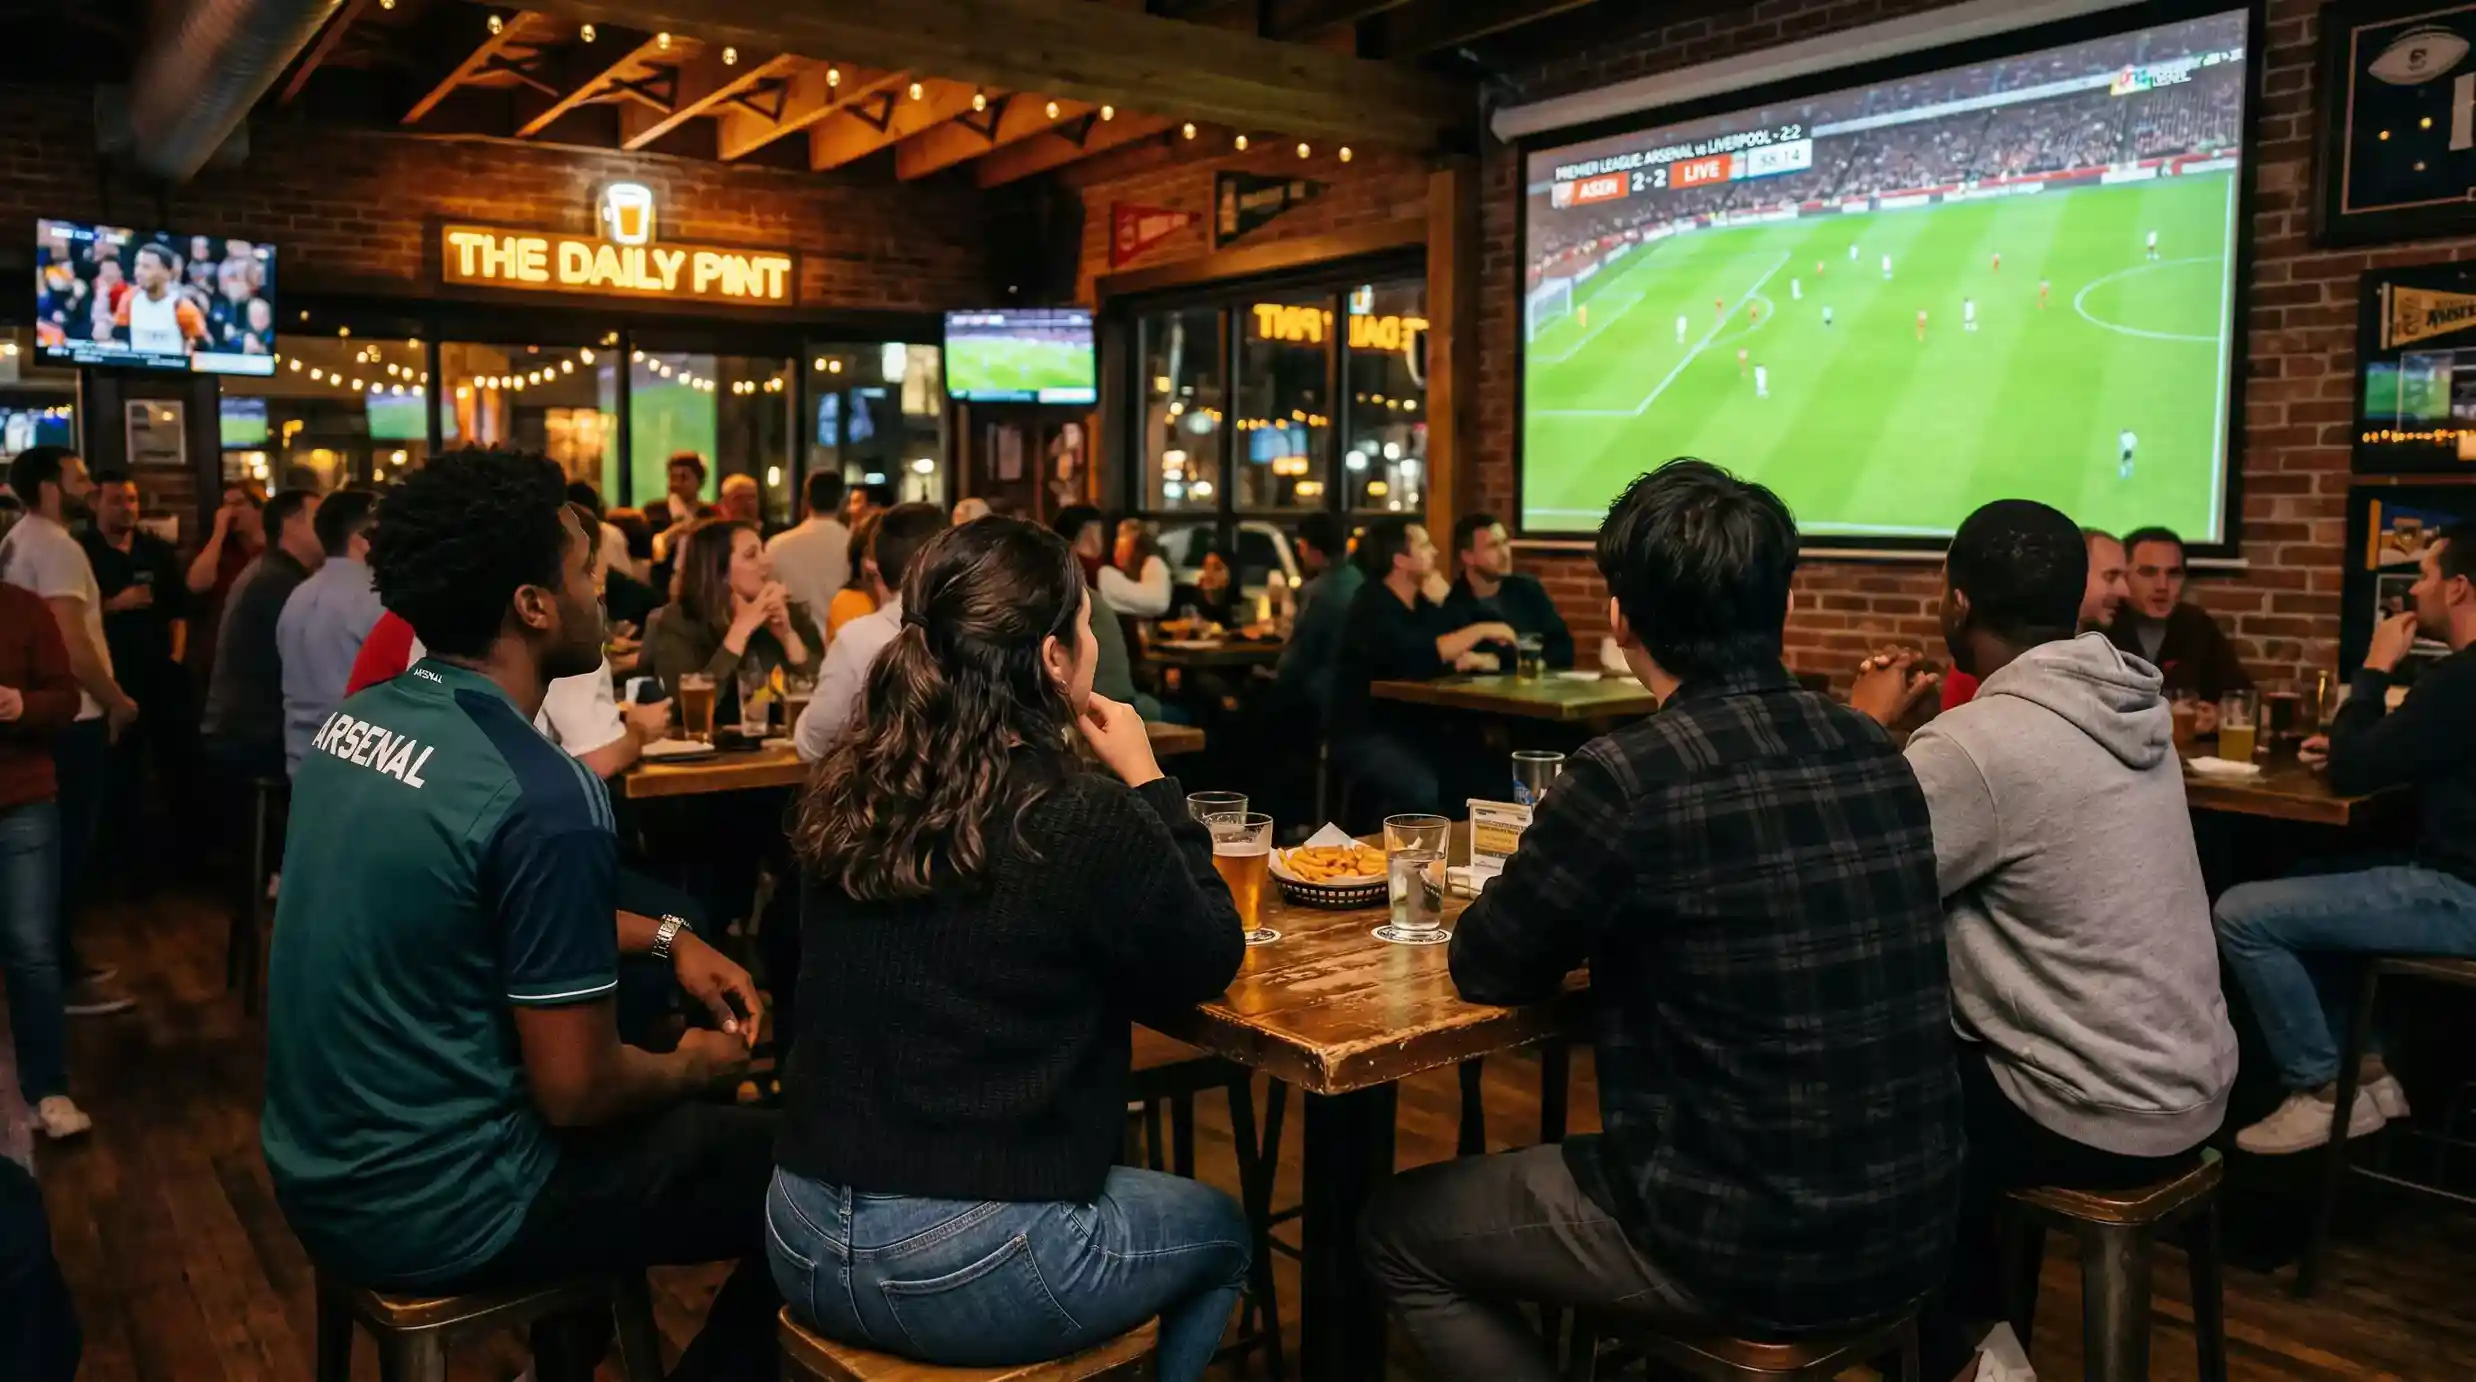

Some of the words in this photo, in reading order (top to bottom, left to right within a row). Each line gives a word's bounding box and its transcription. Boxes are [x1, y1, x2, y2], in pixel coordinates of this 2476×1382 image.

[1555, 160, 1599, 181] PREMIER
[1644, 143, 1695, 165] ARSENAL
[1707, 129, 1772, 155] LIVERPOOL
[1684, 160, 1720, 182] LIVE
[448, 232, 550, 282] THE
[558, 241, 686, 291] DAILY
[693, 252, 792, 299] PINT
[312, 711, 435, 789] ARSENAL
